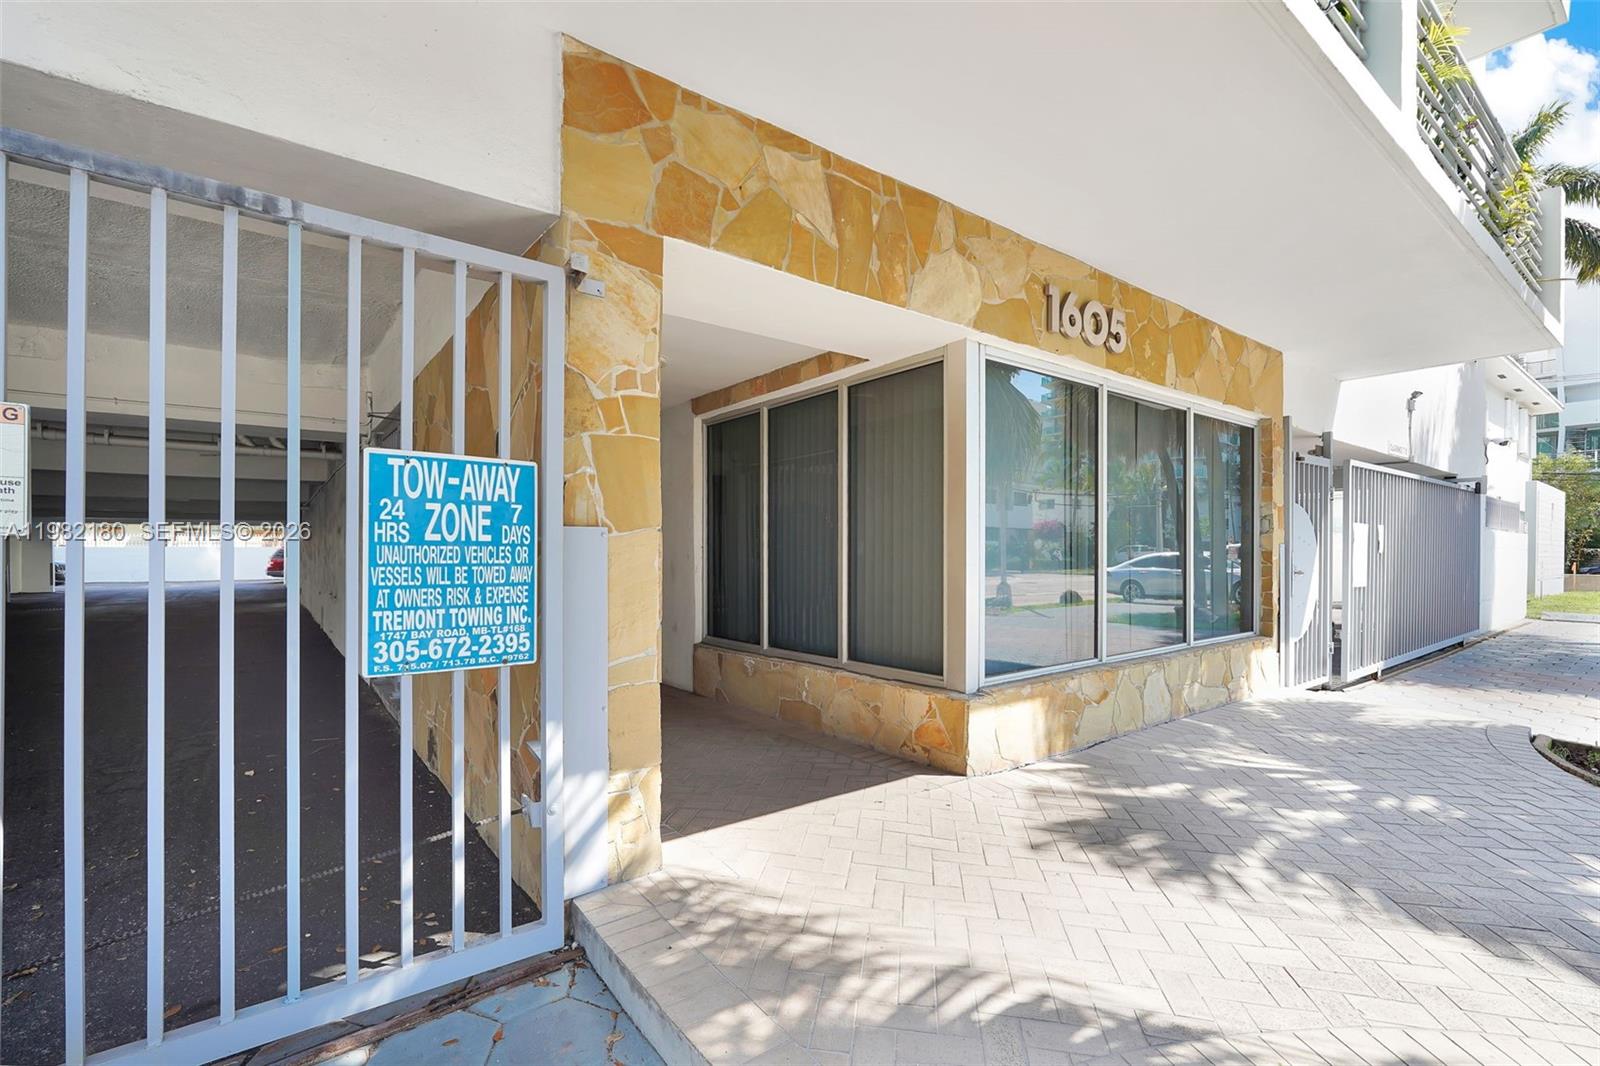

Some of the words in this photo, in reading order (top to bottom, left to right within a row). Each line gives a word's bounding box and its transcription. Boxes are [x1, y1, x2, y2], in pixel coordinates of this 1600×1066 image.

[1044, 282, 1129, 354] 1605
[387, 457, 521, 503] TOW-AWAY
[379, 498, 405, 520] 24
[510, 504, 523, 523] 7
[374, 521, 410, 543] HRS
[424, 502, 492, 542] ZONE
[502, 525, 531, 545] DAYS
[376, 545, 460, 564] UNAUTHORIZED
[464, 545, 512, 564] VEHICLES
[515, 546, 529, 564] OR
[370, 566, 422, 586] VESSELS
[426, 566, 451, 585] WILL
[454, 566, 468, 584] BE
[472, 566, 506, 584] TOWED
[509, 565, 533, 583] AWAY
[376, 589, 390, 608] AT
[394, 588, 442, 608] OWNERS
[446, 587, 471, 606] RISK
[475, 587, 482, 605] &
[486, 586, 529, 604] EXPENSE
[372, 608, 446, 631] TREMONT
[449, 606, 502, 627] TOWING
[506, 605, 531, 624] INC.
[380, 631, 407, 641] 1747
[410, 630, 433, 639] BAY
[436, 628, 469, 637] ROAD,
[373, 632, 531, 664] 305-672-2395
[442, 657, 476, 667] 713.78
[478, 656, 499, 664] M.C.
